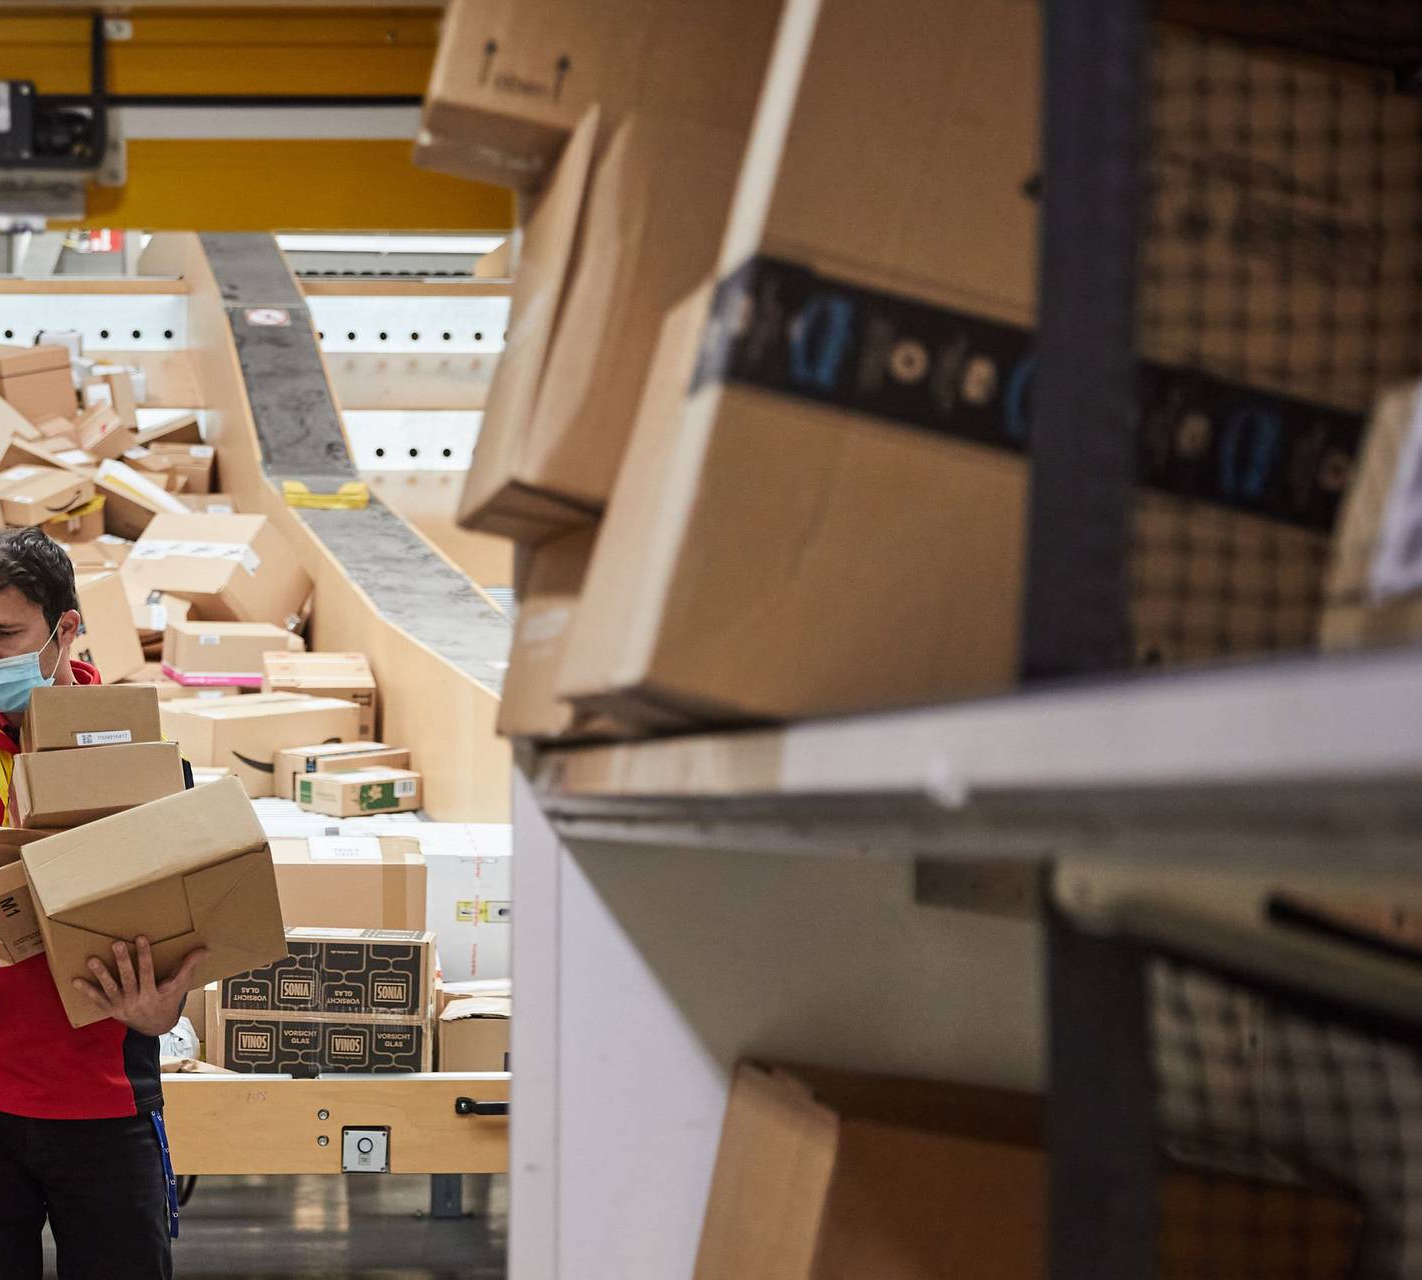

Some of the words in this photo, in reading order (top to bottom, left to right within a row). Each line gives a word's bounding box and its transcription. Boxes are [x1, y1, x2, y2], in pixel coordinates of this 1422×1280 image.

[0, 895, 18, 919] M1
[283, 982, 310, 996] VINOS
[377, 986, 403, 1000] VINOS
[233, 994, 267, 1002] VORSICHT
[241, 1035, 267, 1049] VINOS
[291, 1037, 310, 1045] GLAS
[378, 1033, 410, 1041] VORSICHT
[334, 1038, 360, 1052] VINOS
